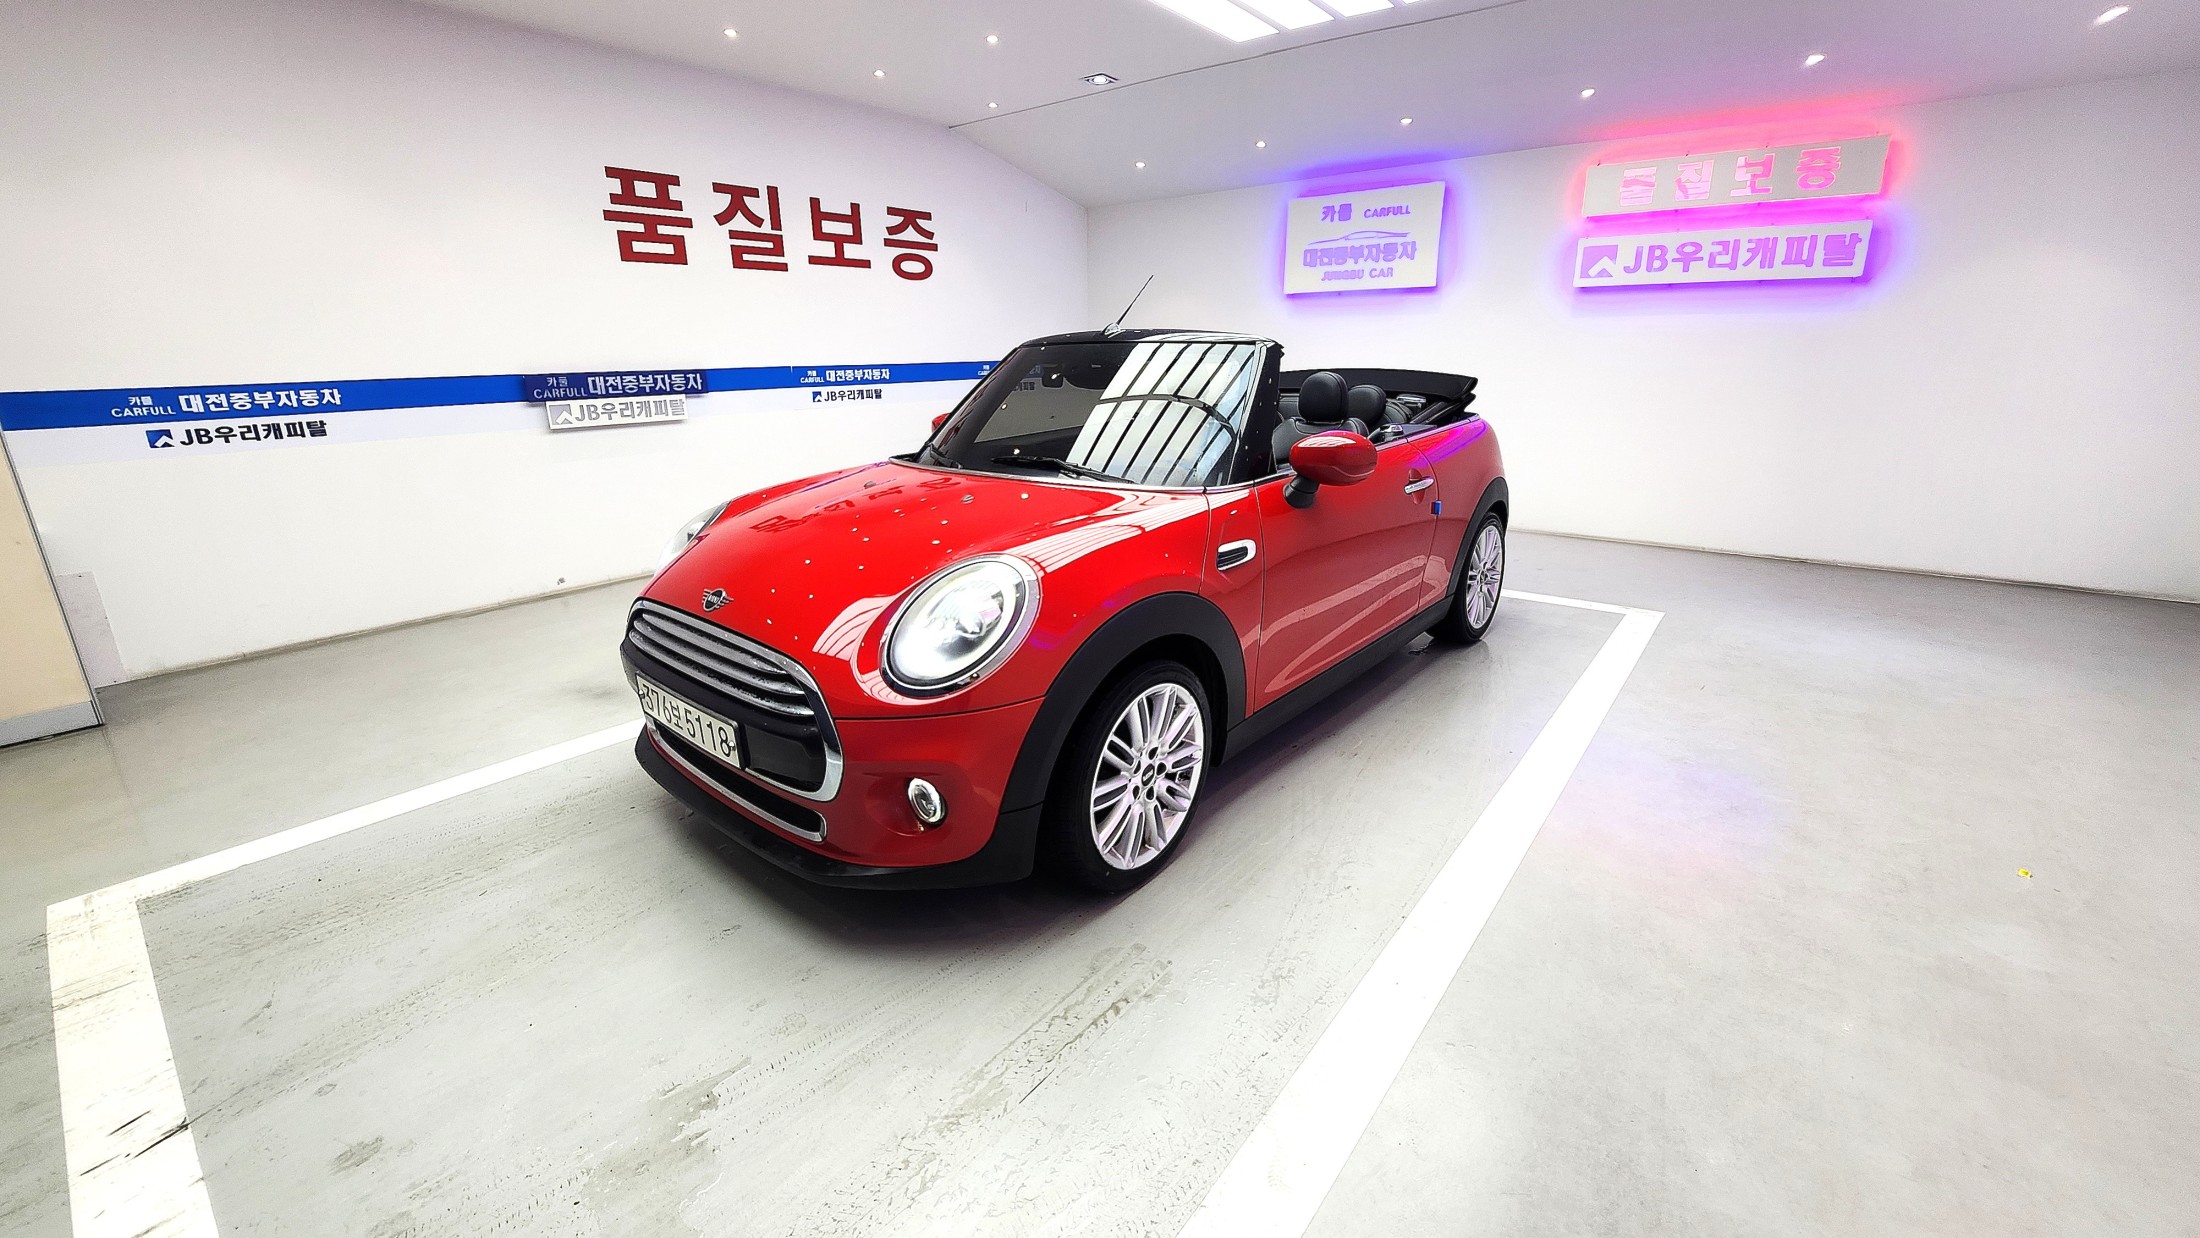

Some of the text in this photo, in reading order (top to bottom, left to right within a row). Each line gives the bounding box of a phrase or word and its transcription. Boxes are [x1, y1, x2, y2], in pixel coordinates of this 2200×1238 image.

[1363, 205, 1411, 219] CARFULL
[603, 166, 939, 281] 품질보증
[1623, 233, 1862, 274] JB우리캐피탈
[1369, 267, 1394, 279] CAR
[587, 373, 703, 395] 대전중부자동차
[826, 369, 890, 382] 대전중부자동차
[178, 388, 342, 413] 대전중부자동차
[533, 387, 588, 399] CARFULL
[111, 405, 175, 417] CARFULL
[575, 398, 686, 422] JB우리캐피탈
[180, 420, 328, 446] JB우리캐피탈
